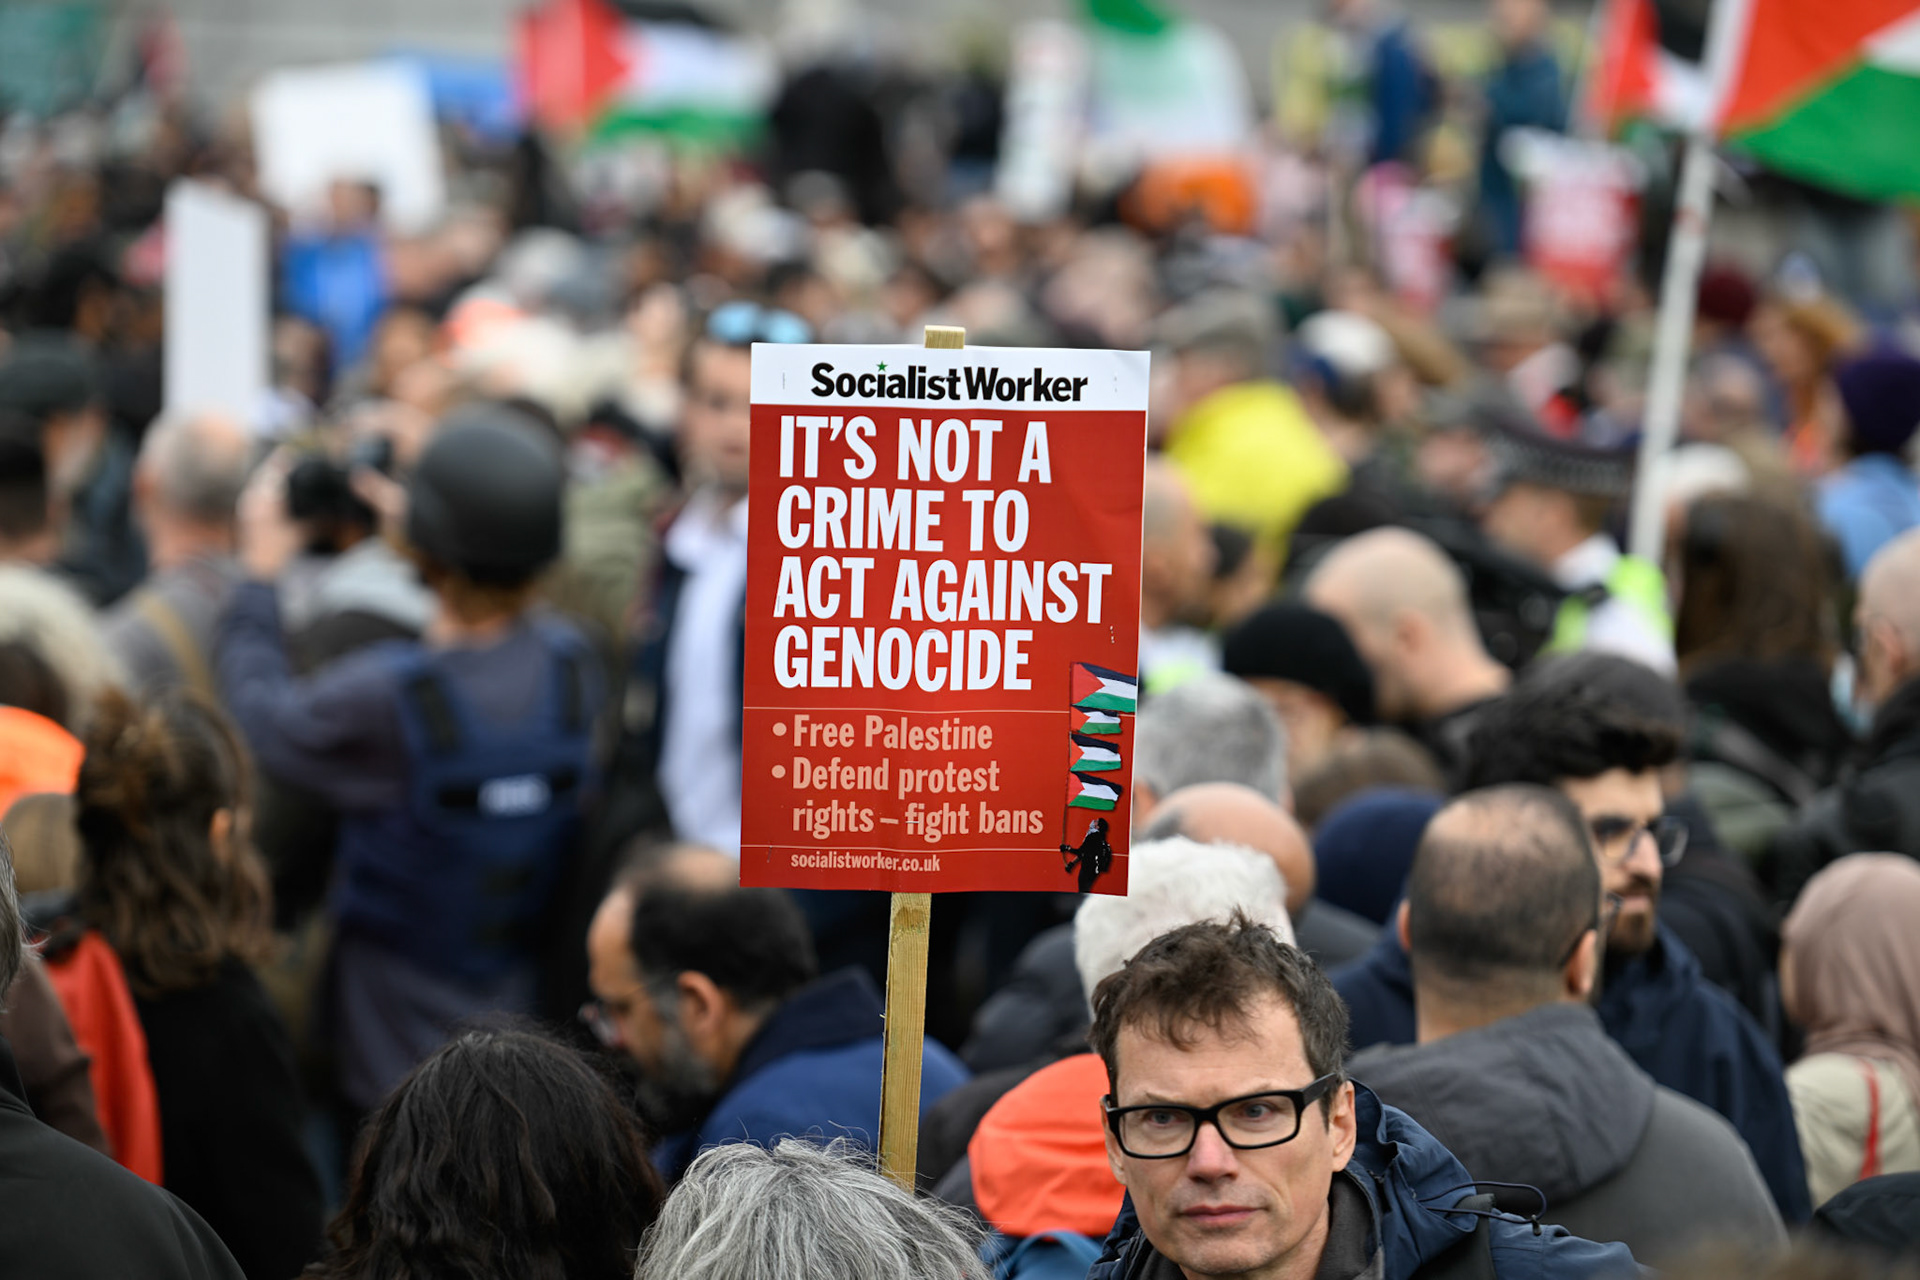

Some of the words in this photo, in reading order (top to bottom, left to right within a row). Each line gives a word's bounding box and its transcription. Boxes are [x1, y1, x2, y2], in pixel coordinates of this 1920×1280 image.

[811, 363, 960, 400] Socialist
[964, 367, 1088, 402] Worker
[780, 416, 876, 479] IT’S
[898, 418, 1002, 482] NOT
[1018, 421, 1051, 483] A
[778, 485, 944, 552] CRIME
[962, 490, 1029, 552] TO
[774, 556, 874, 619] ACT
[890, 559, 1112, 623] AGAINST
[774, 625, 1033, 692] GENOCIDE
[794, 715, 854, 747] Free
[865, 716, 992, 751] Palestine
[793, 757, 889, 790] Defend
[899, 761, 999, 799] protest
[793, 800, 874, 839] rights
[905, 803, 969, 843] fight
[979, 802, 1043, 833] bans
[791, 851, 941, 871] socialistworker.co.uk
